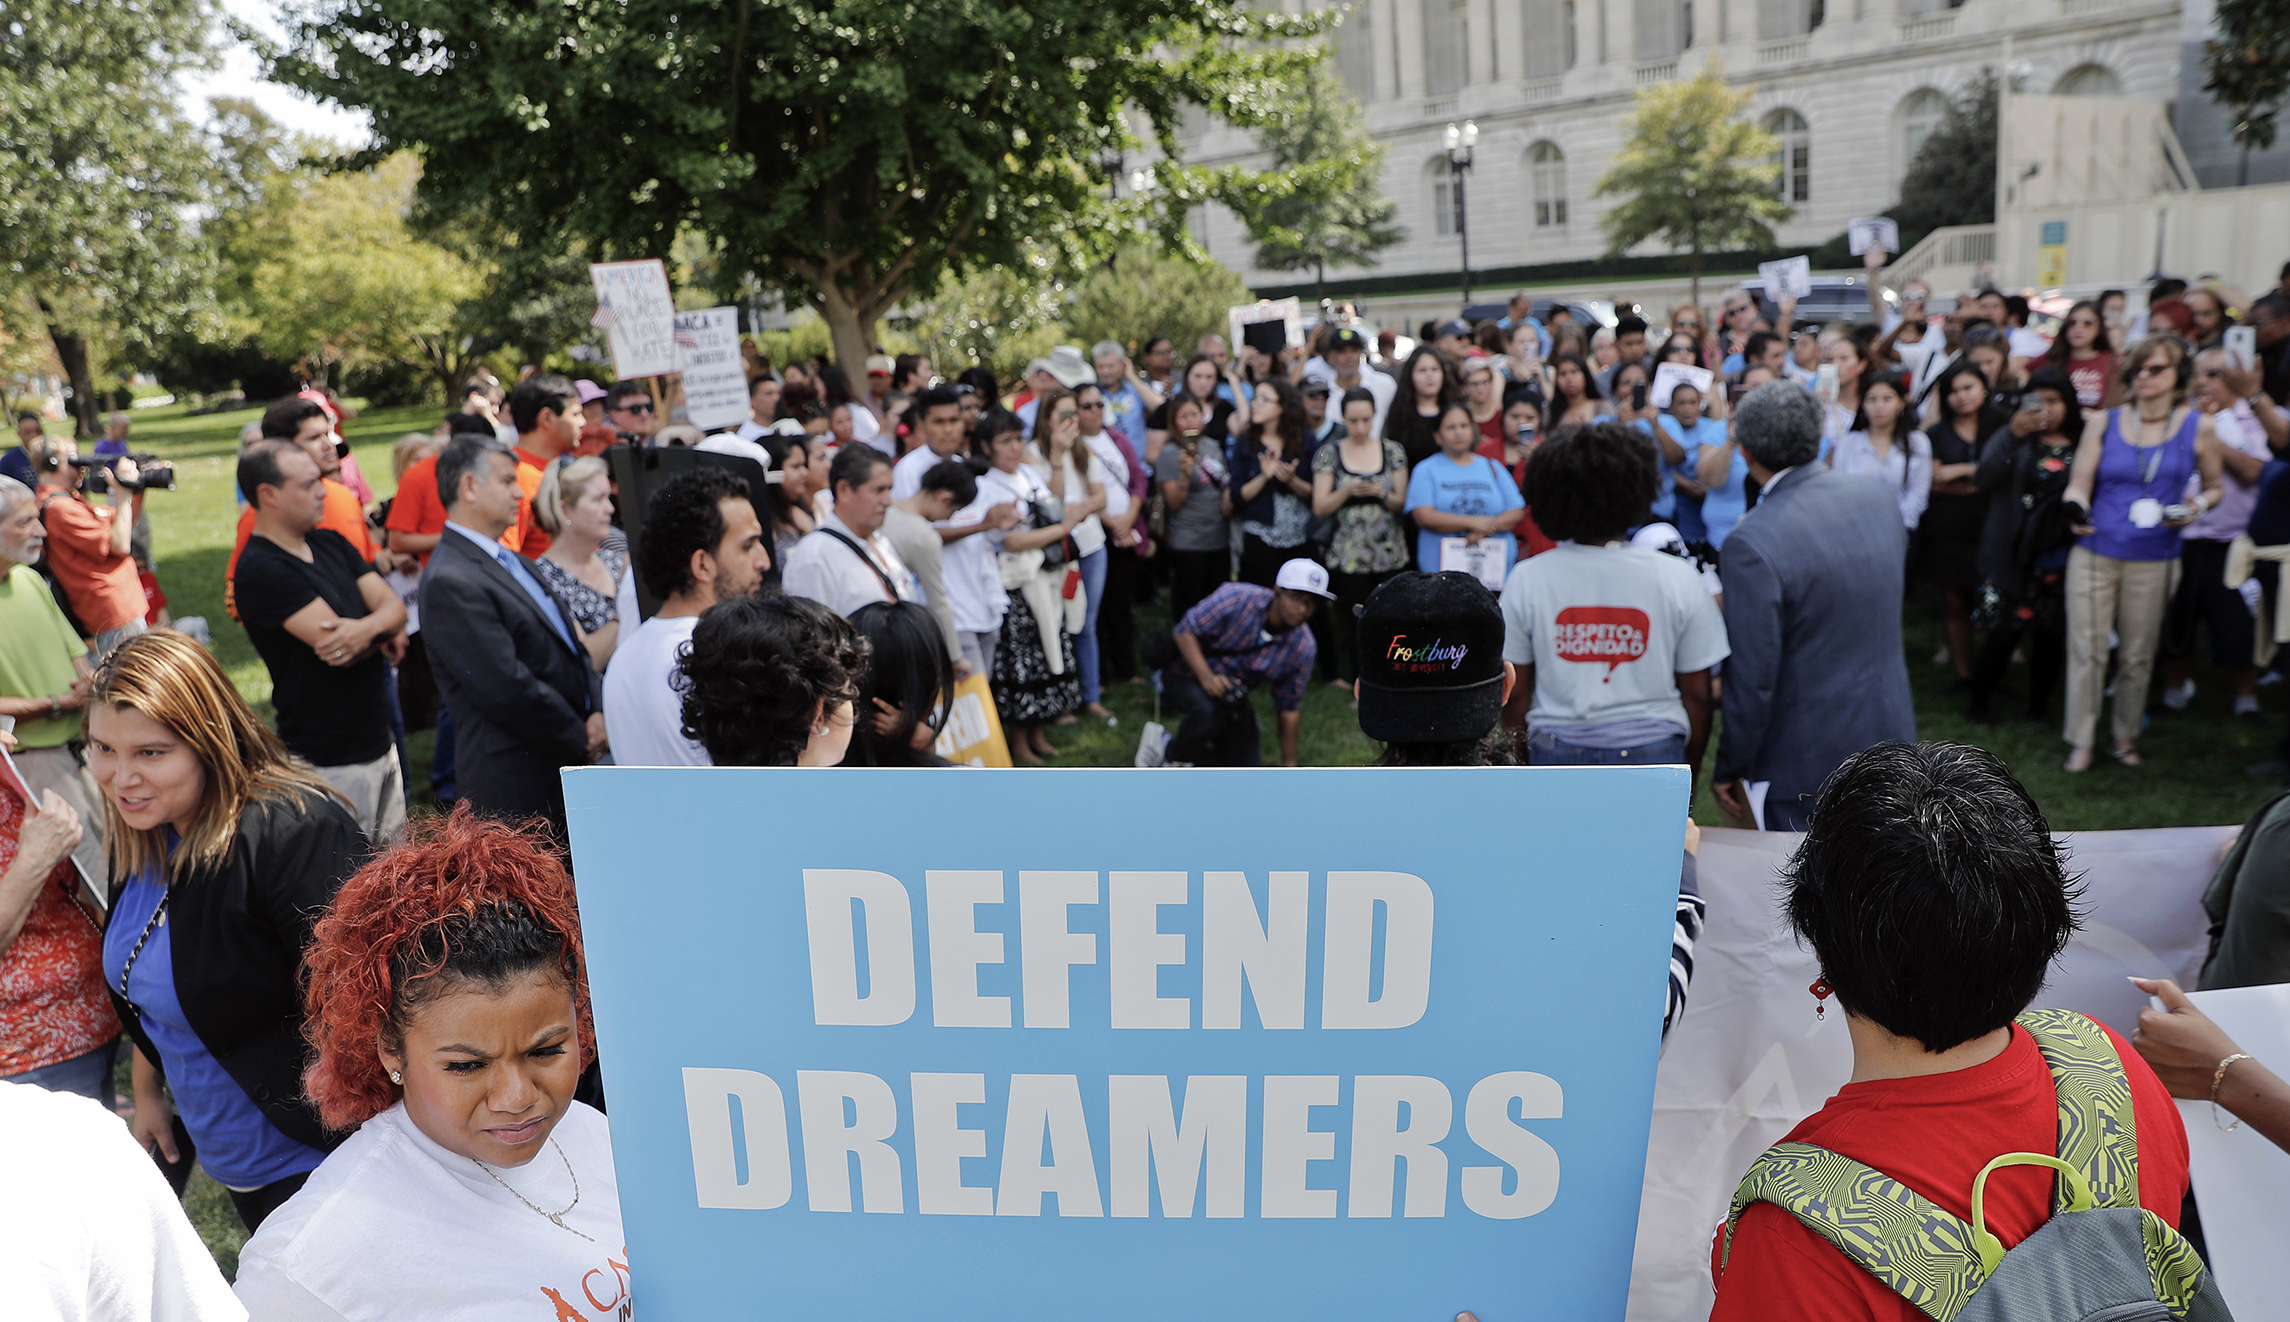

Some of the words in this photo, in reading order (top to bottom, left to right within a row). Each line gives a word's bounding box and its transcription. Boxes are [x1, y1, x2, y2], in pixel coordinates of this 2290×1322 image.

[625, 285, 649, 304] NO
[1386, 634, 1469, 670] Frostburg
[1555, 639, 1645, 657] DIGNIDAD
[802, 868, 1435, 1031] DEFEND
[681, 1066, 1565, 1221] DREAMERS
